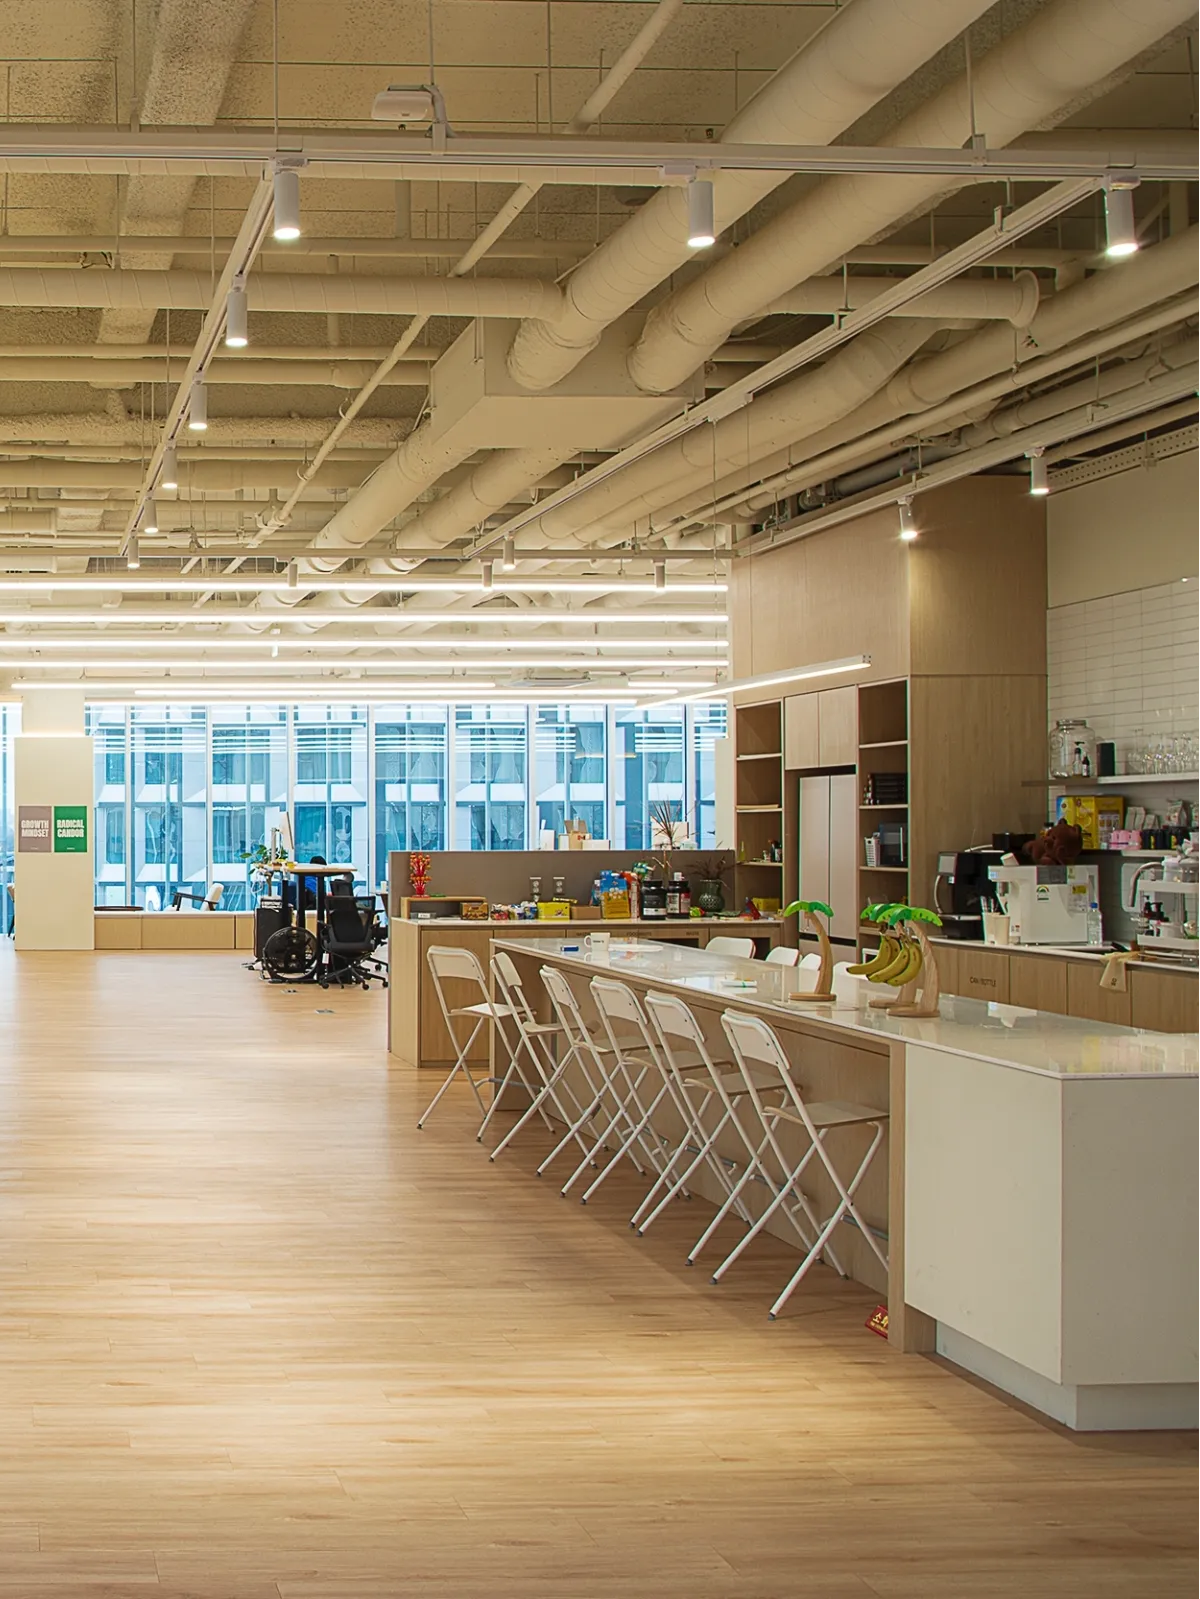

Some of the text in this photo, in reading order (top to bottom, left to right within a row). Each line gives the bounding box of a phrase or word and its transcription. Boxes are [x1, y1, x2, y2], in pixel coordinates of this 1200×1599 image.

[21, 820, 49, 828] GROWTH
[57, 820, 84, 828] RADICAL
[21, 829, 49, 837] MINDSET
[57, 829, 84, 837] CANDOR
